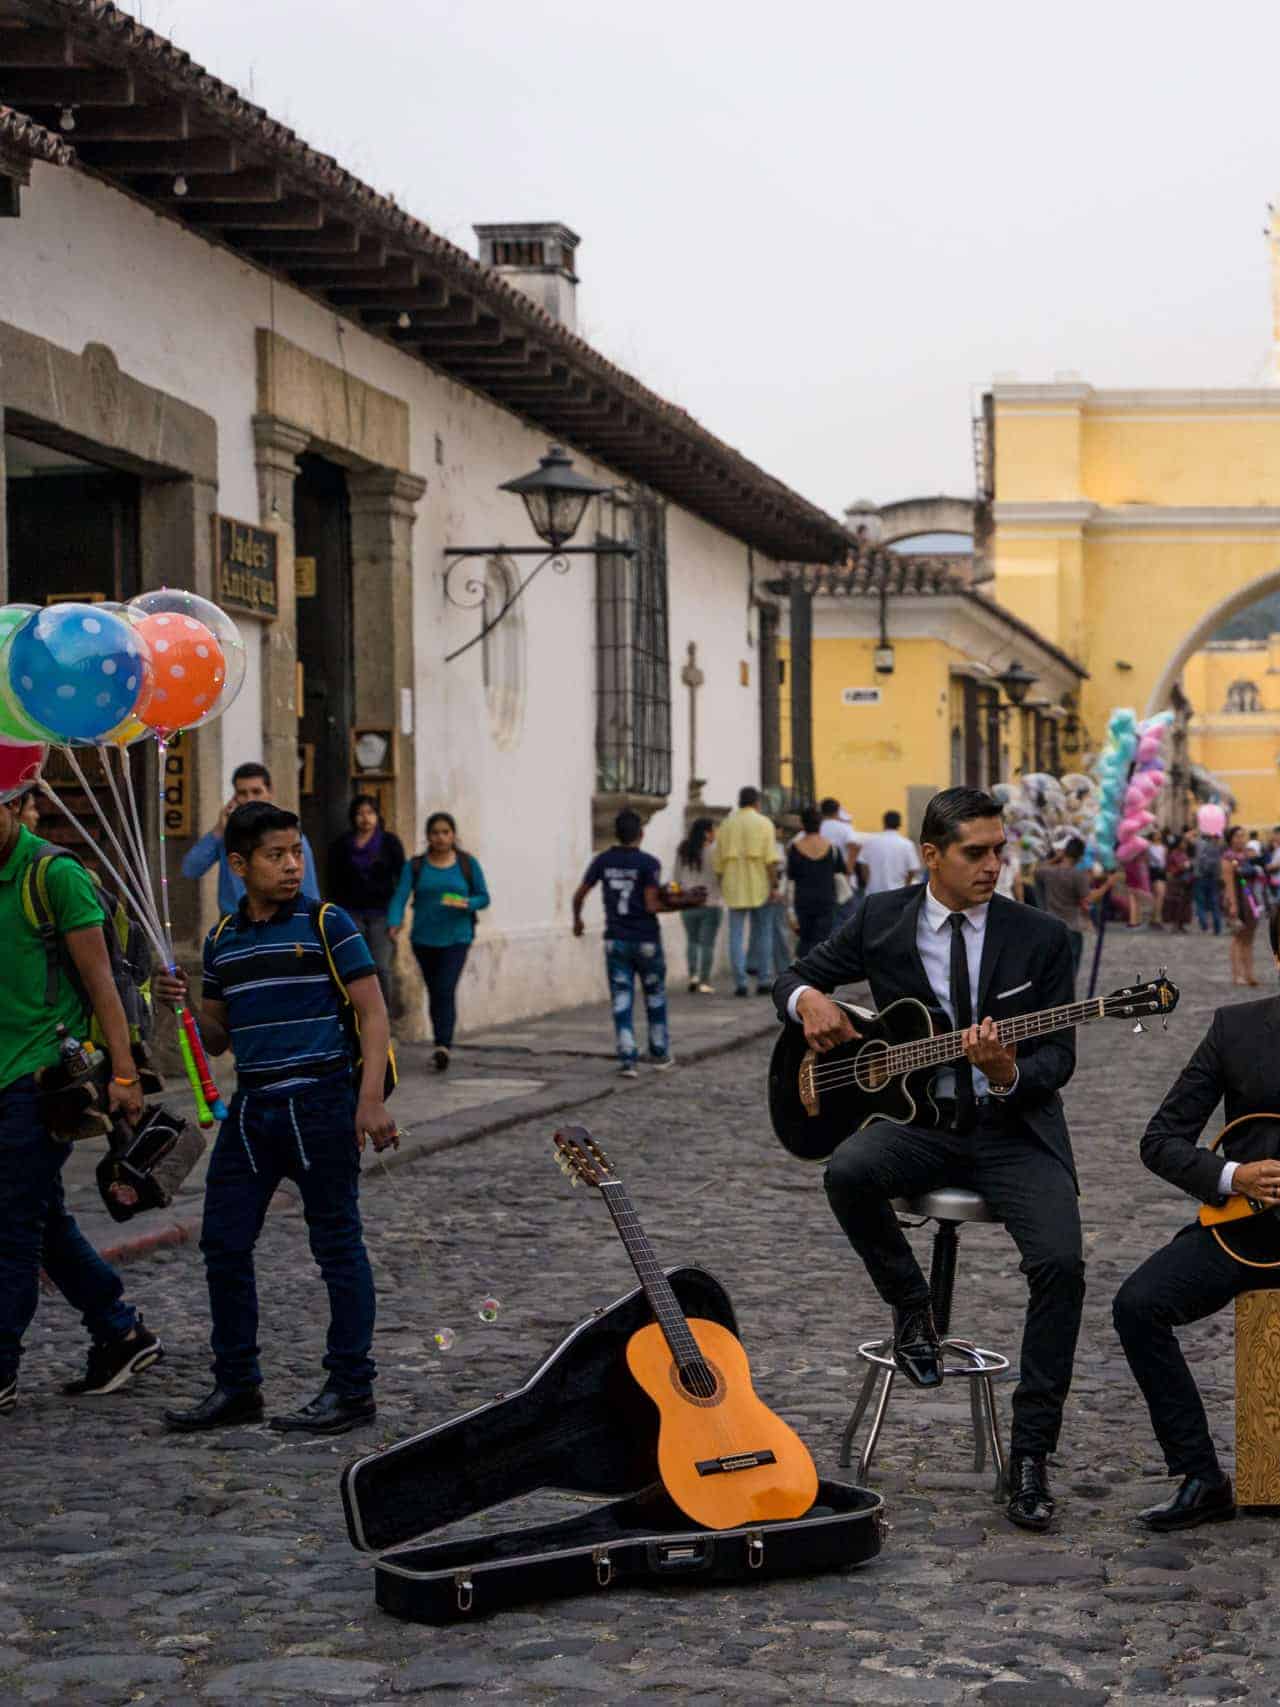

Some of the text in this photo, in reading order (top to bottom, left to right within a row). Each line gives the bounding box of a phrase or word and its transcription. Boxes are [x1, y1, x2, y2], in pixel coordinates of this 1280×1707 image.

[230, 520, 269, 568] Jades
[221, 561, 276, 611] Antigua
[609, 879, 634, 916] 7
